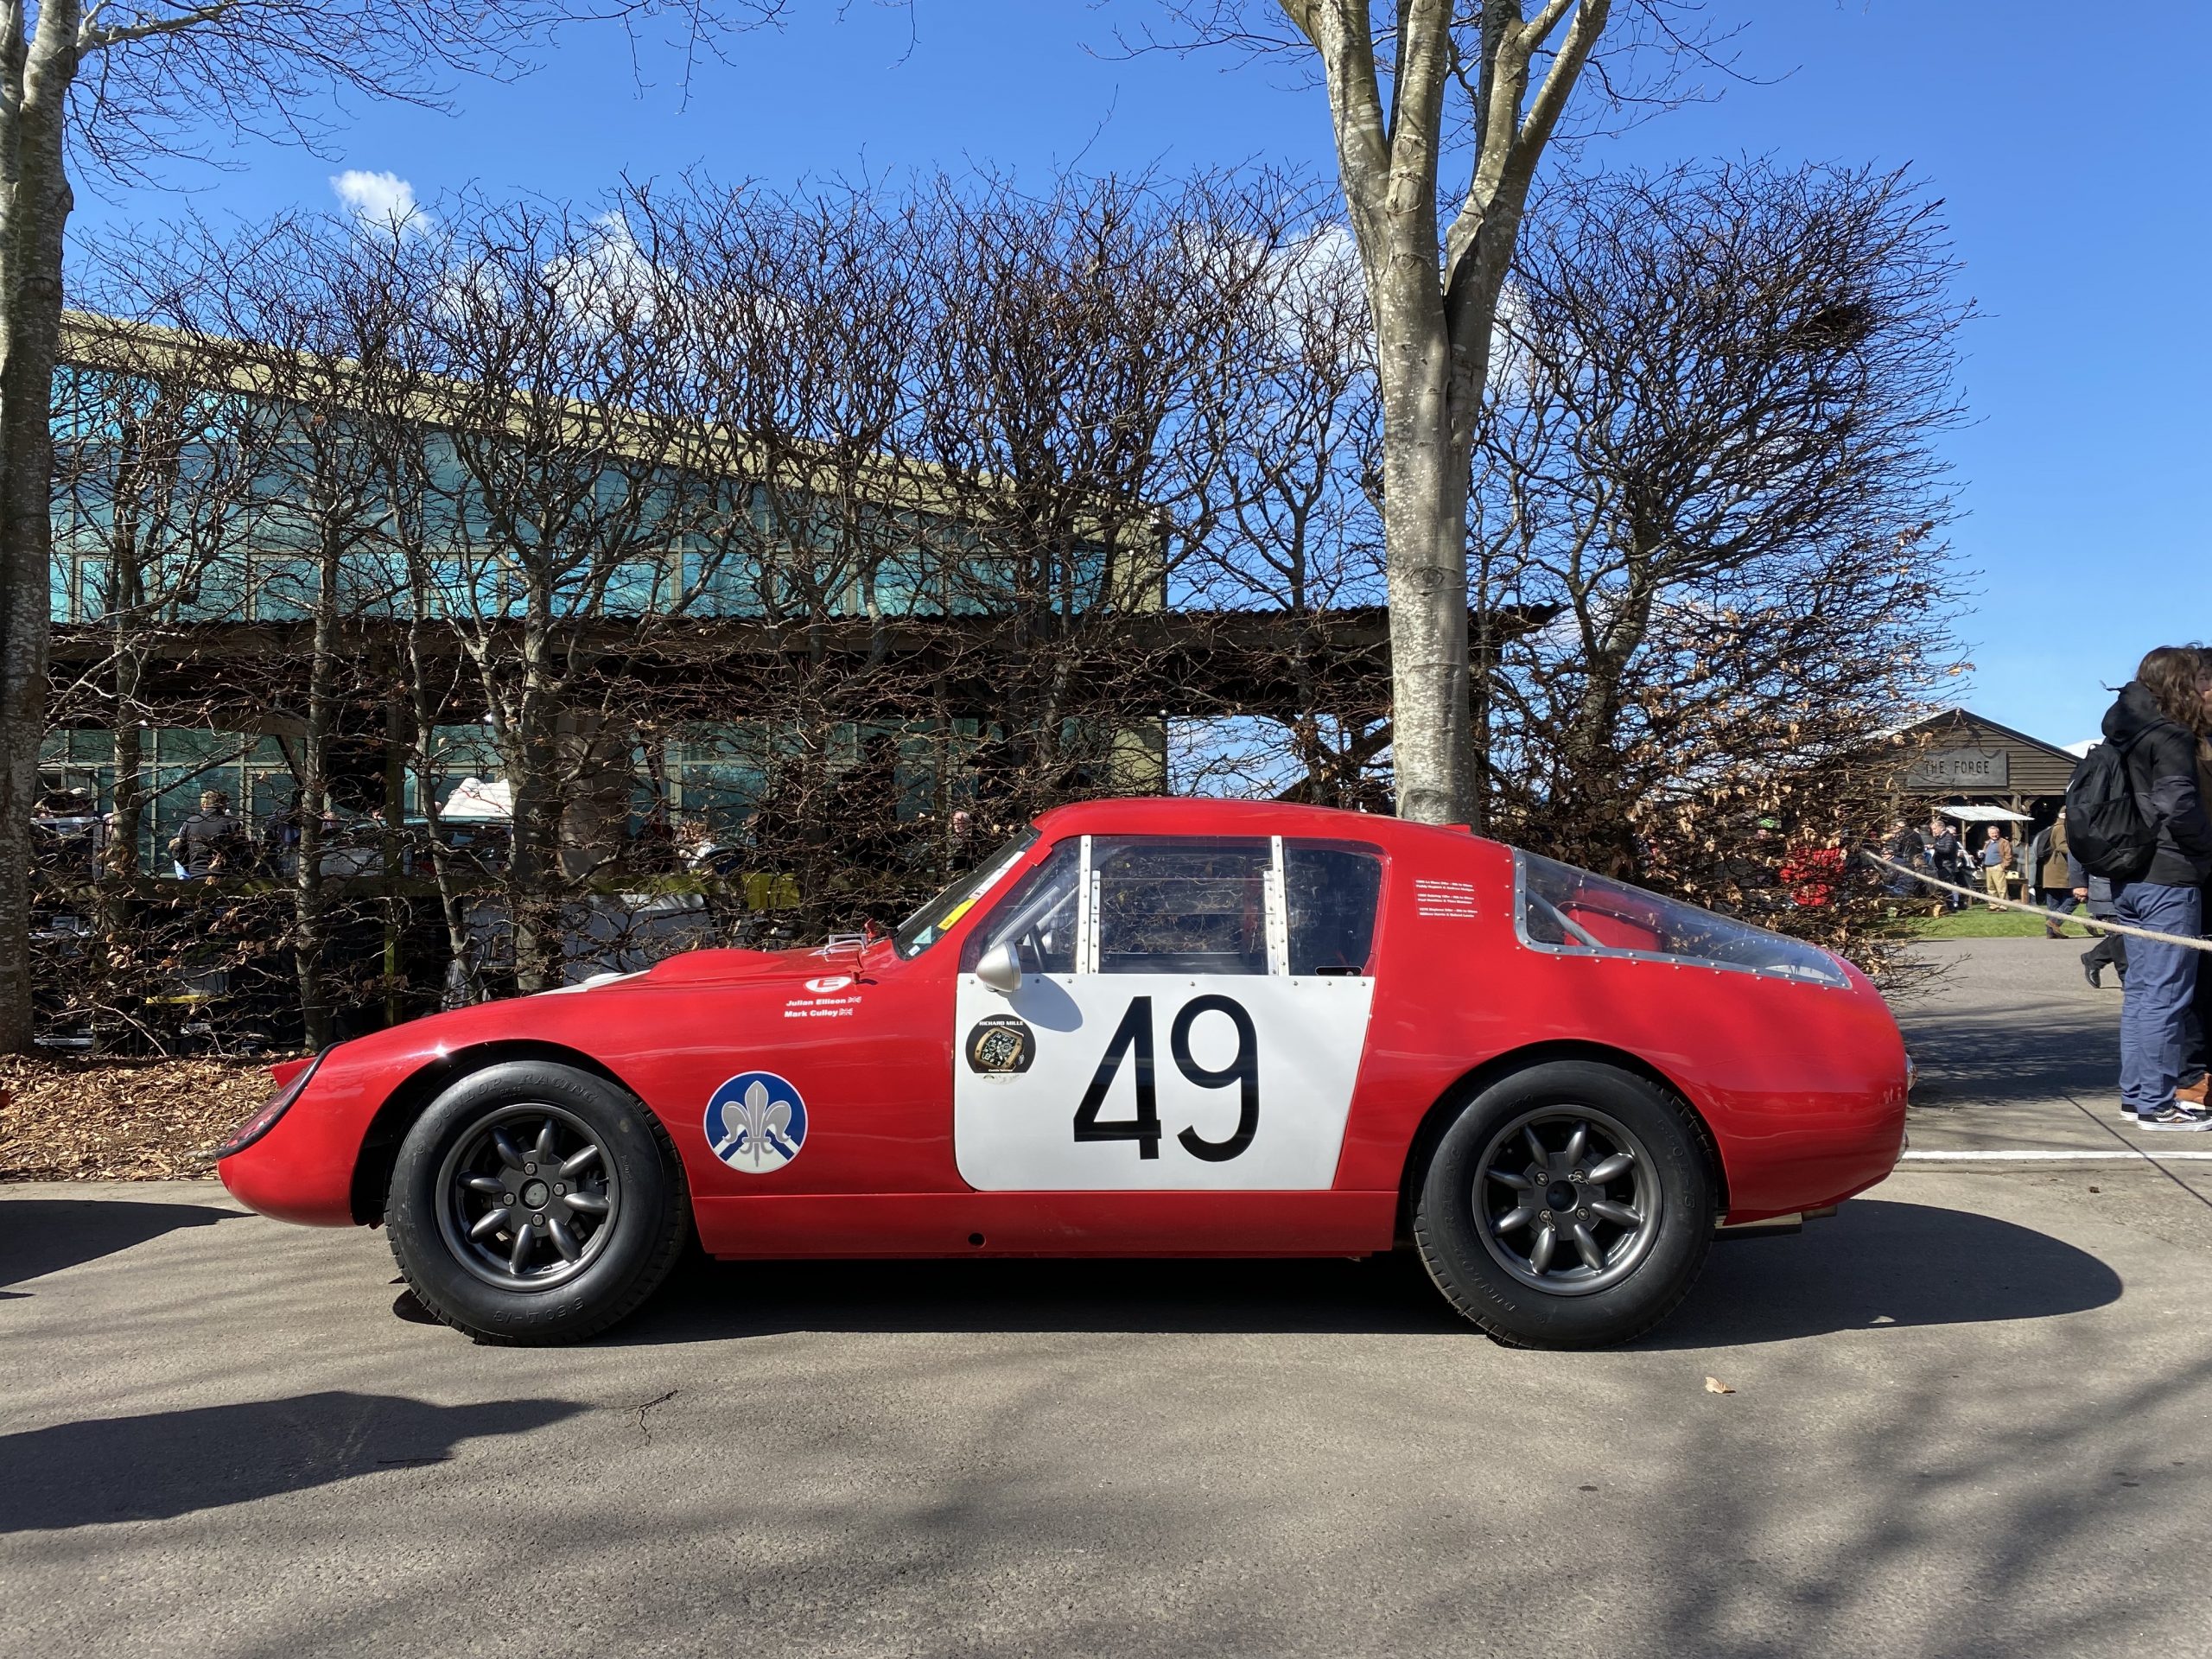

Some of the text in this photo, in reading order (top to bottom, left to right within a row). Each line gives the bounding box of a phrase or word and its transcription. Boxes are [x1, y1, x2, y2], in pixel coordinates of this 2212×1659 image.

[1924, 760, 1990, 774] THE FORGE
[518, 1074, 600, 1103] RACING
[1073, 994, 1260, 1162] 49
